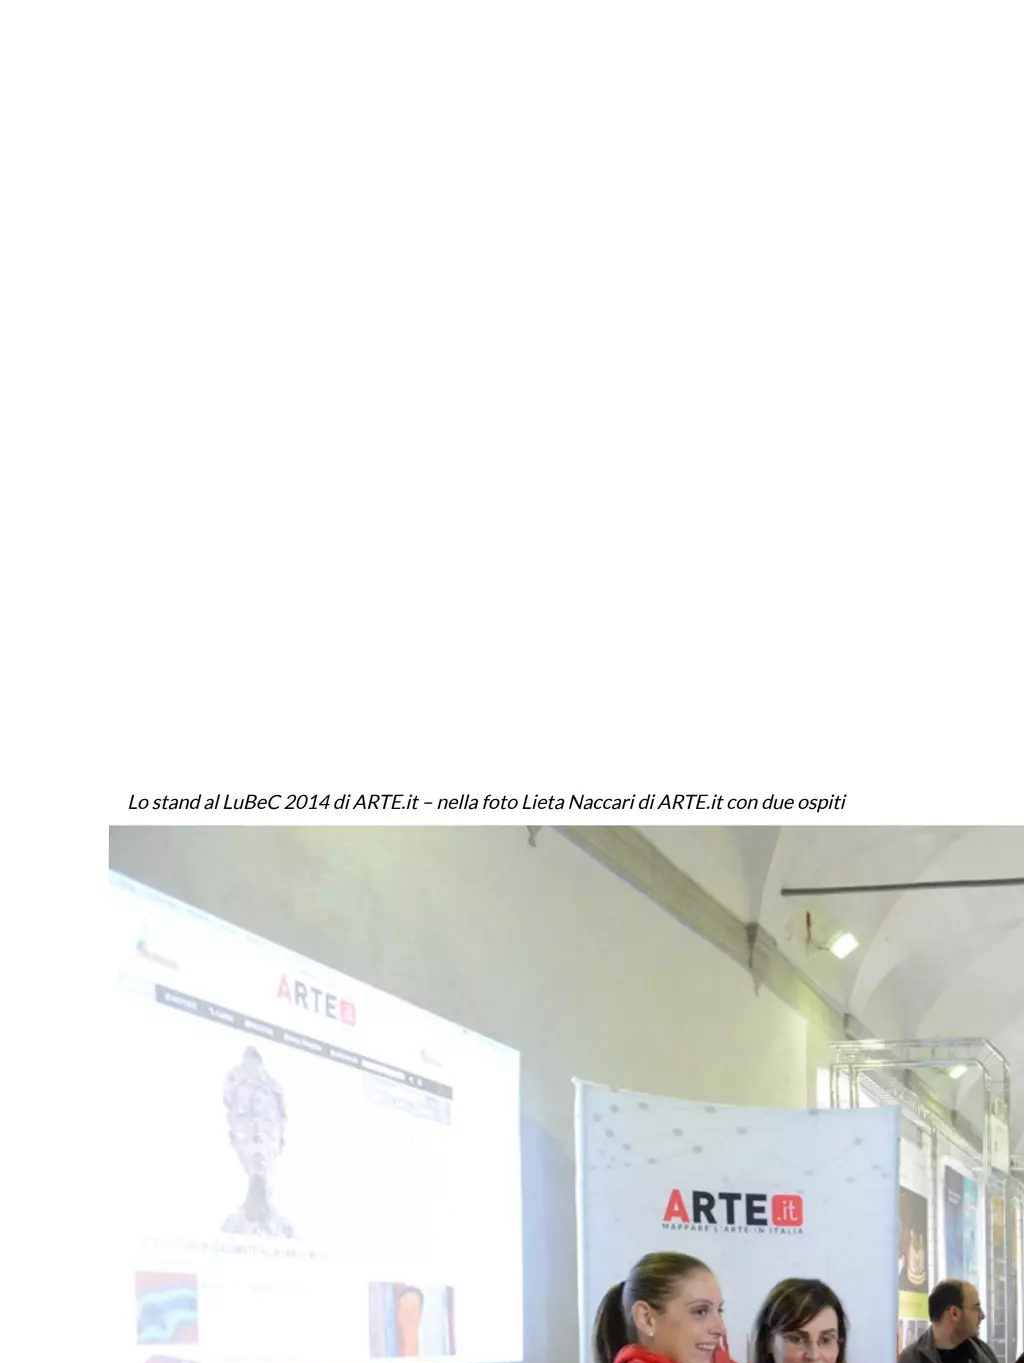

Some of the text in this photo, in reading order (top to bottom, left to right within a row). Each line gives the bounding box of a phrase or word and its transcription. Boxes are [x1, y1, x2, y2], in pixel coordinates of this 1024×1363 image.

[661, 1223, 709, 1233] MAPPARE
[754, 1227, 765, 1235] IN
[769, 1227, 804, 1235] ITALIA
